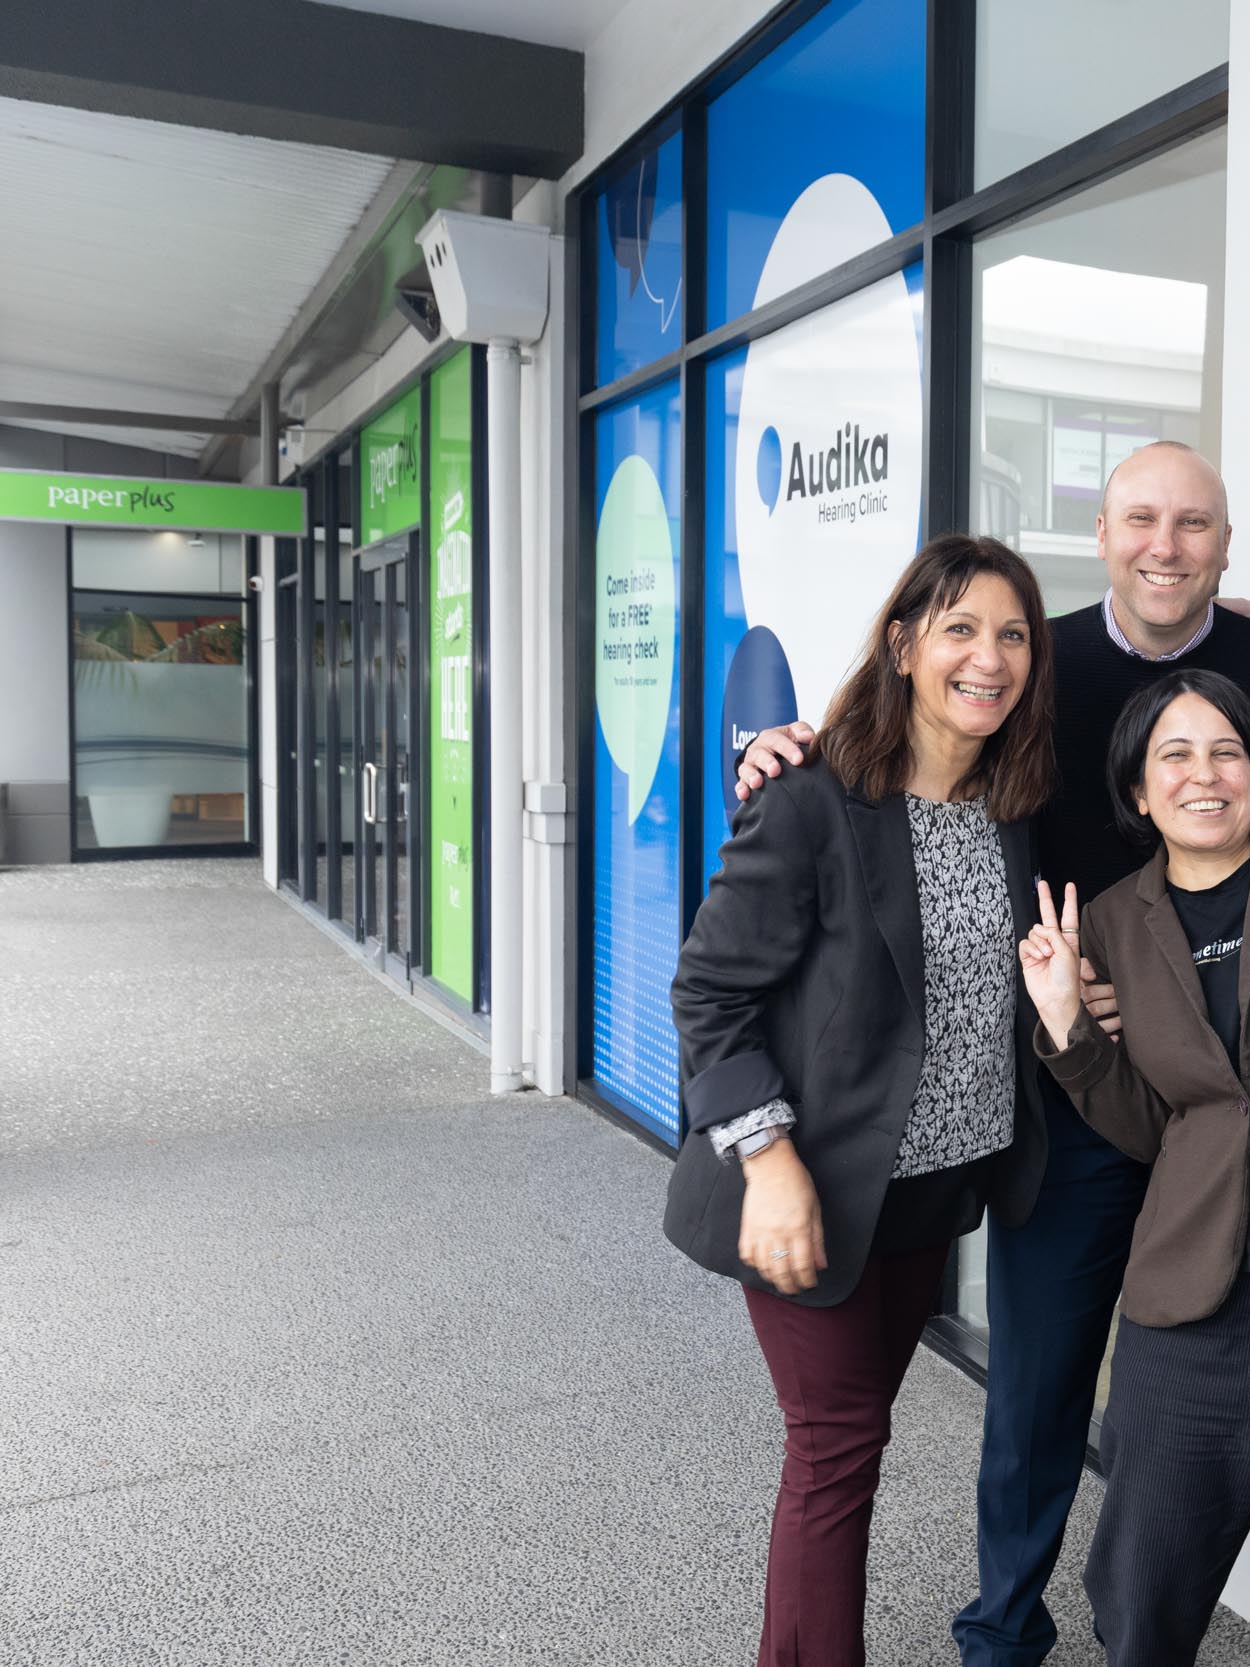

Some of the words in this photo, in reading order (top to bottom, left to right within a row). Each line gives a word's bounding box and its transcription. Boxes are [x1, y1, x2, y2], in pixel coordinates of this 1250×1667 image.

[786, 421, 888, 501] Audika
[818, 499, 856, 523] Hearing
[859, 489, 888, 515] Clinic
[607, 575, 628, 596] Come
[630, 567, 656, 592] inside
[608, 607, 619, 628] for
[621, 611, 626, 627] a
[603, 636, 632, 665] hearing
[634, 635, 659, 659] check
